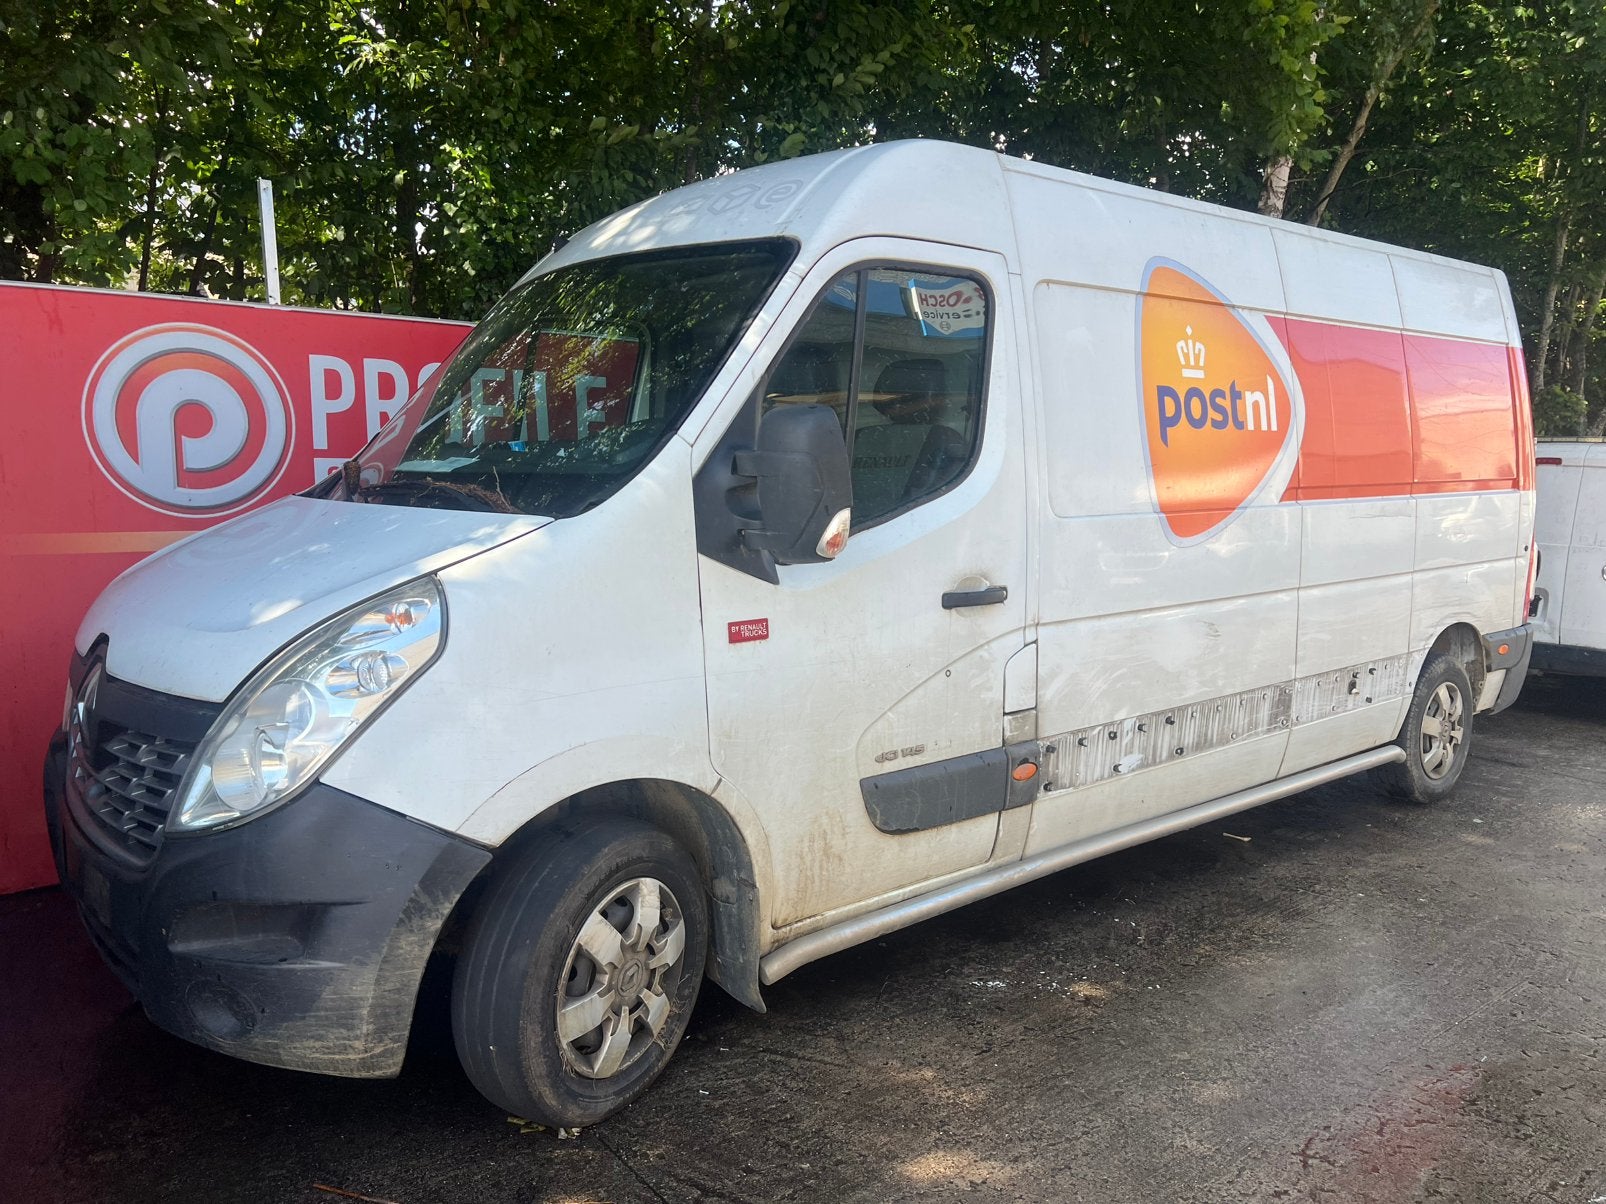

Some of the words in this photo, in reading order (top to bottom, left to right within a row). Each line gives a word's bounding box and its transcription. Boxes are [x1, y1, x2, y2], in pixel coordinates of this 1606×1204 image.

[1156, 374, 1278, 448] postnl
[731, 625, 740, 633] BY
[740, 622, 767, 632] RENAULT
[741, 628, 768, 638] TRUCKS
